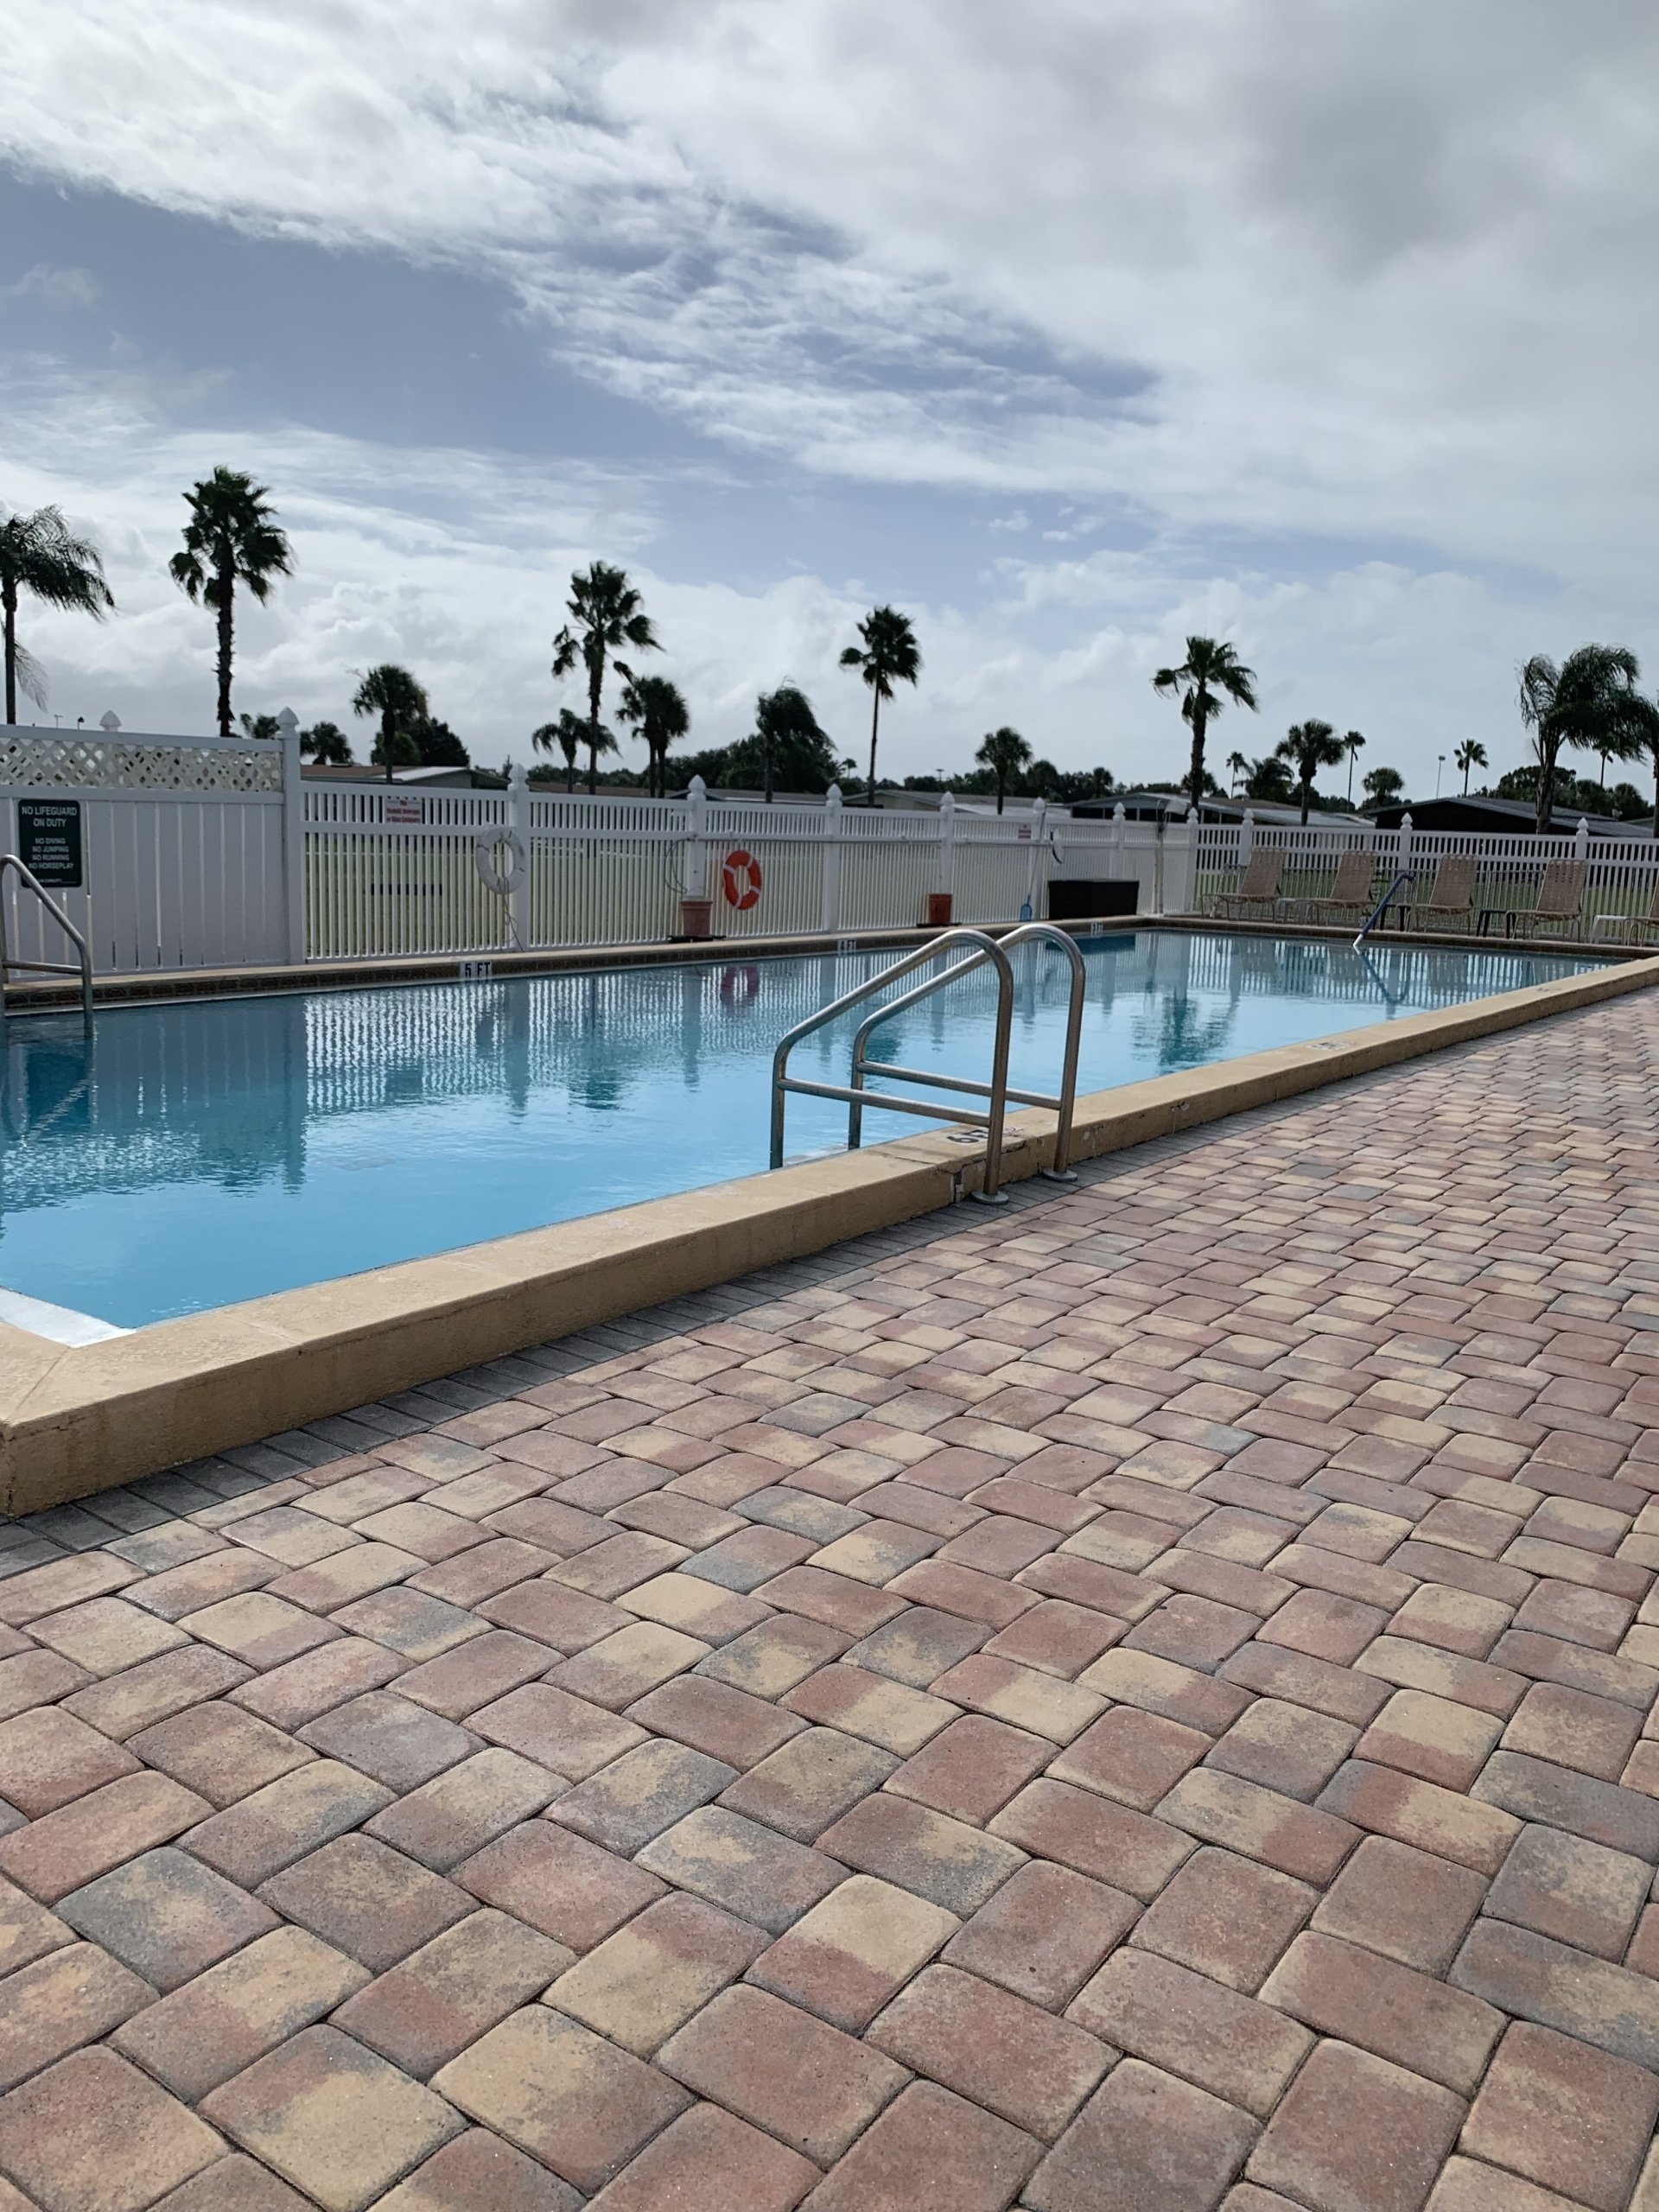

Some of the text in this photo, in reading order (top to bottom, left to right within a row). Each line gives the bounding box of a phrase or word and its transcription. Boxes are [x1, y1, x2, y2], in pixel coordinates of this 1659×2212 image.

[22, 806, 77, 816] NO LIFEGUARD
[34, 818, 67, 827] ON DUTY
[465, 962, 491, 977] 5 FT
